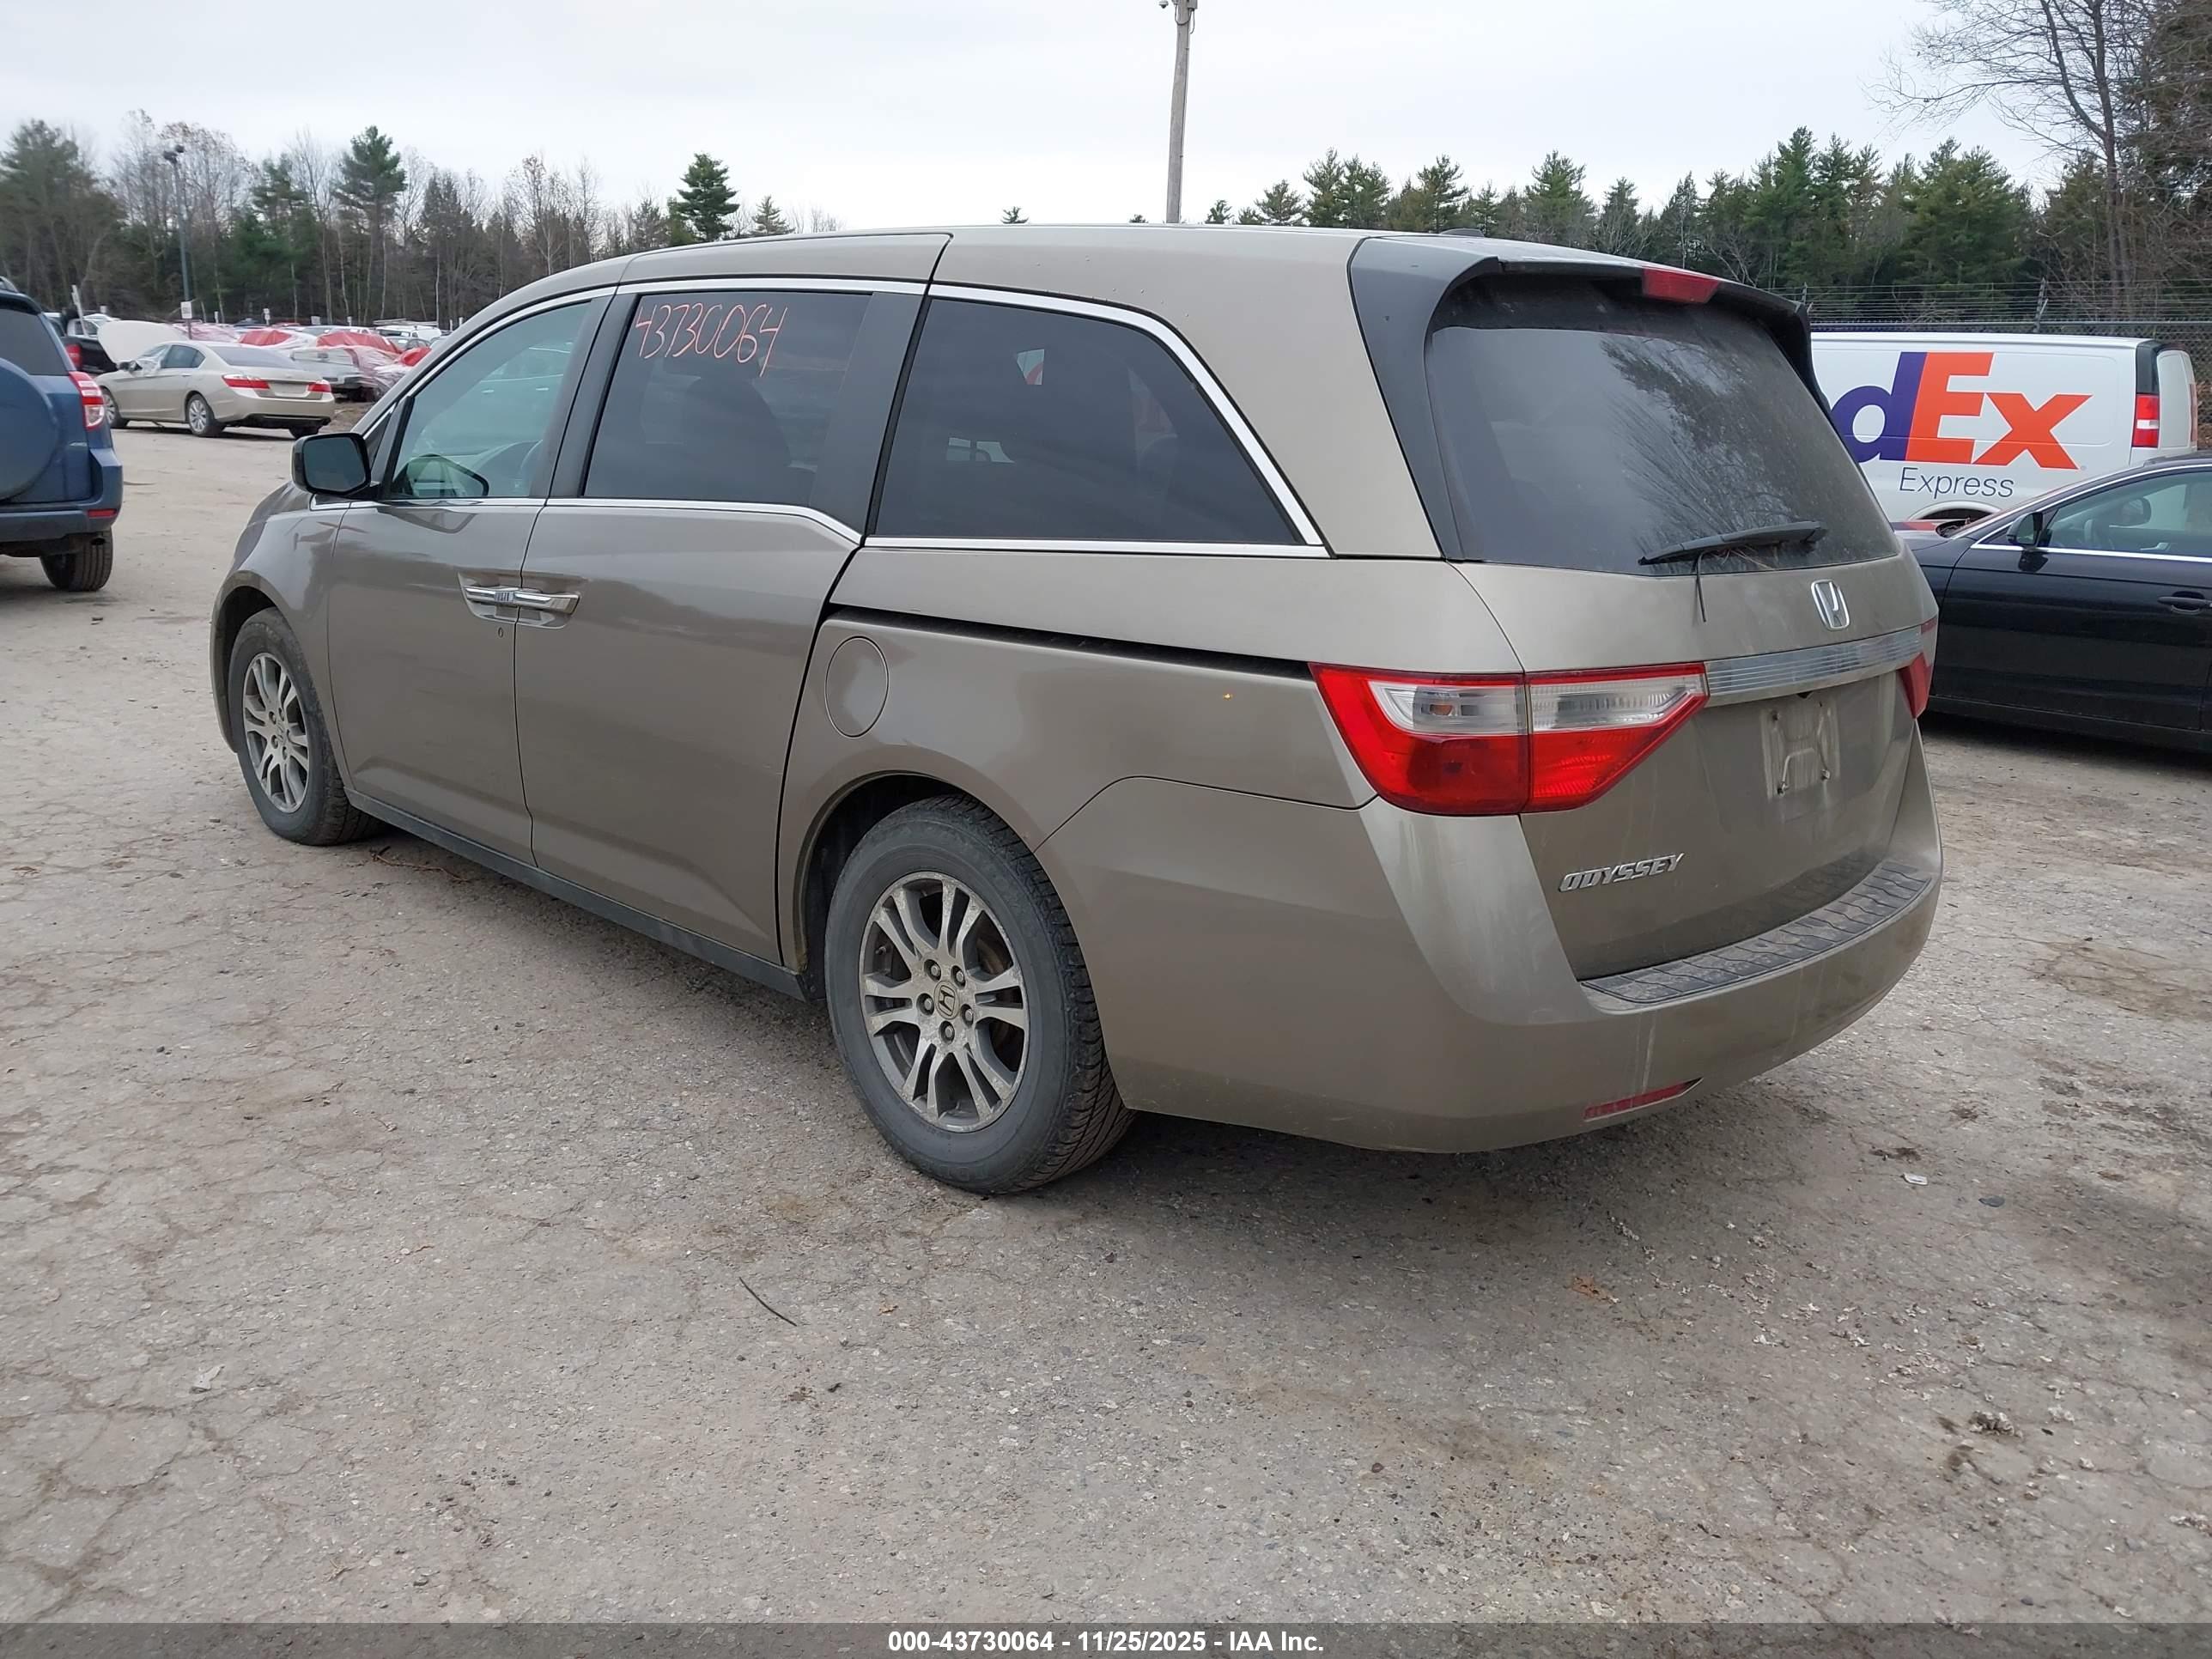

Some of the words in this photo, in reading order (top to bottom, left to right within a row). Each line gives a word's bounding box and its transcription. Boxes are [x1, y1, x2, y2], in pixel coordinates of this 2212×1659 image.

[635, 302, 788, 378] 43730064
[1899, 466, 2014, 500] Express
[1559, 853, 1685, 892] ODYSSEY
